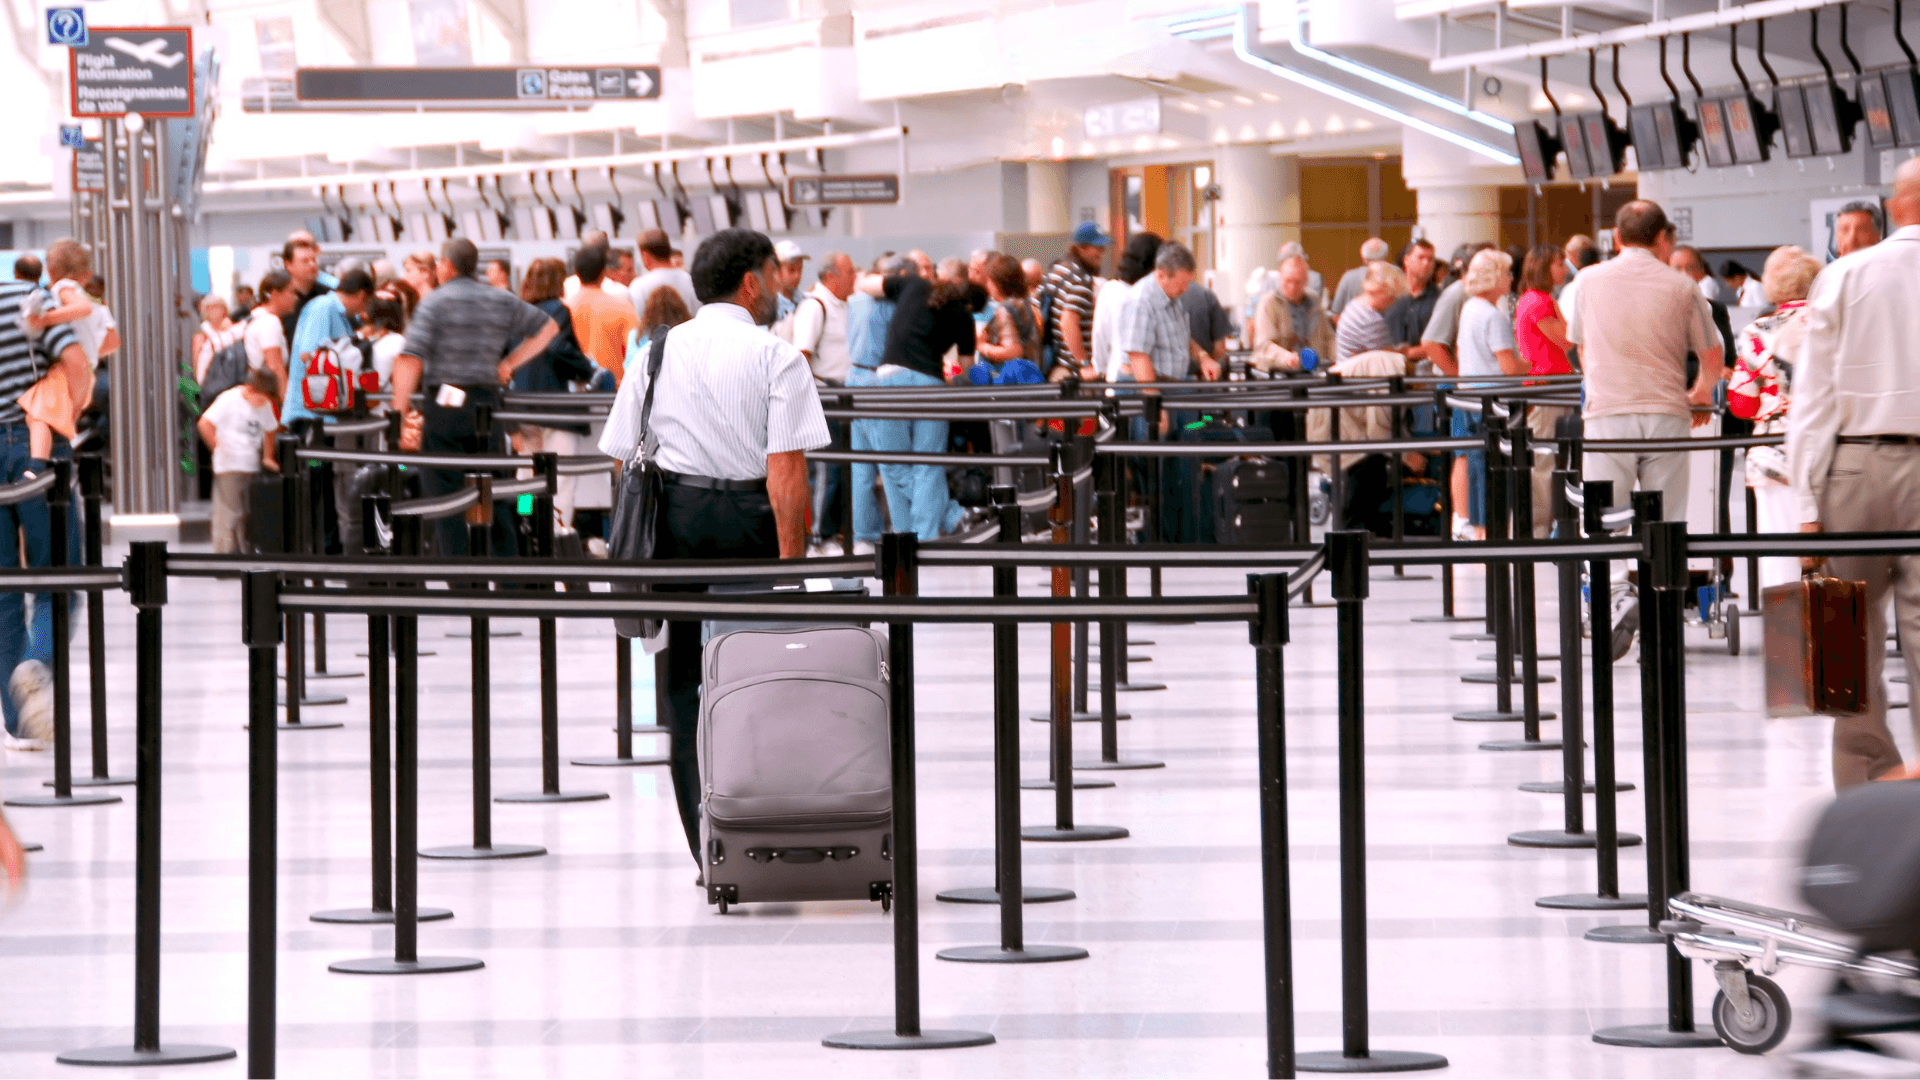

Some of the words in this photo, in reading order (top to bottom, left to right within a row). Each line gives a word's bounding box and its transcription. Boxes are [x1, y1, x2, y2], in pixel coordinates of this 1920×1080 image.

[77, 53, 115, 68] Flight
[549, 70, 590, 84] Gates
[78, 86, 187, 103] Renseignements
[549, 84, 595, 97] Portes
[78, 100, 97, 112] de
[98, 100, 126, 112] vols
